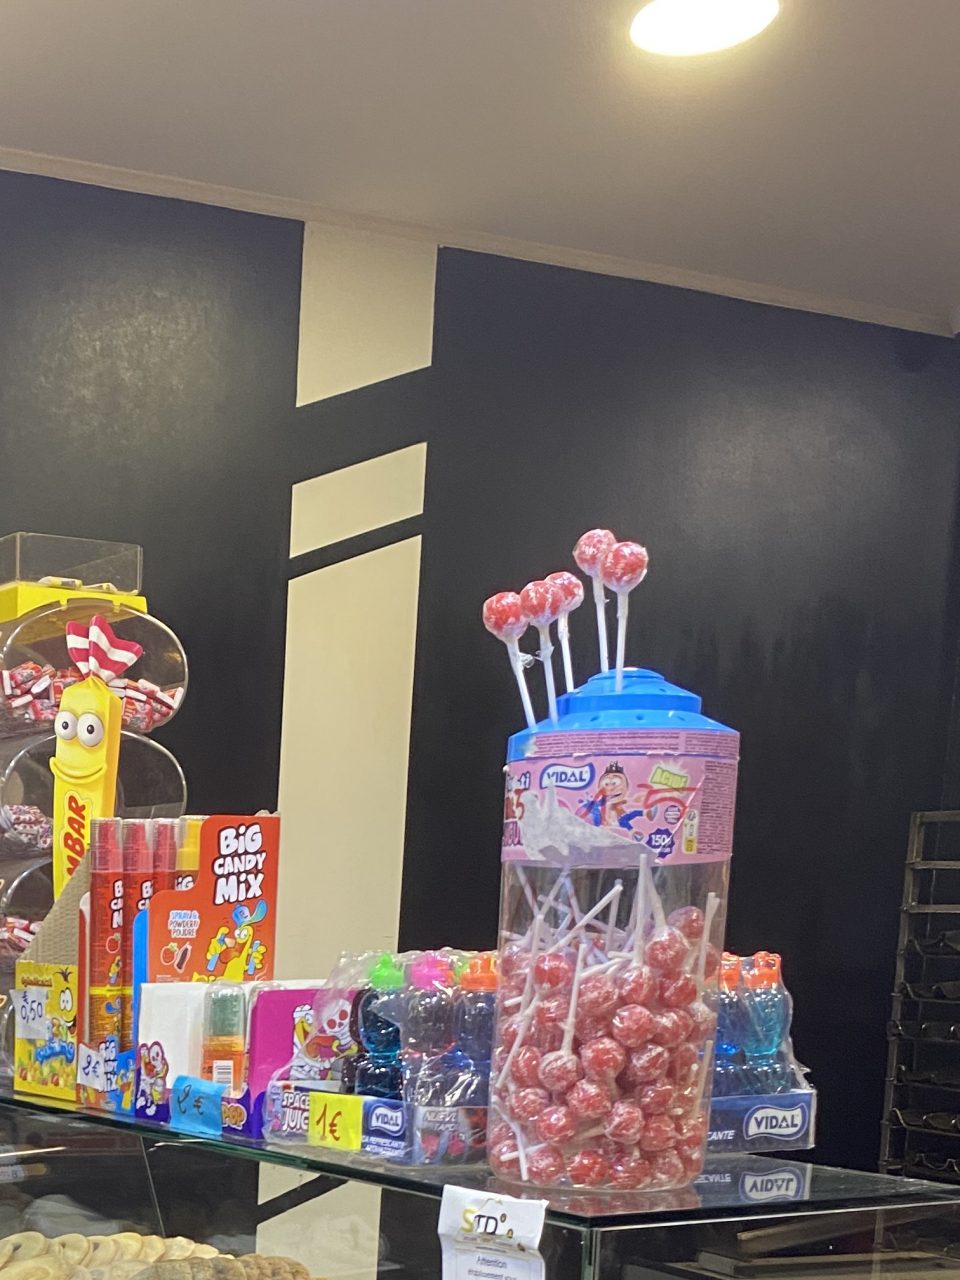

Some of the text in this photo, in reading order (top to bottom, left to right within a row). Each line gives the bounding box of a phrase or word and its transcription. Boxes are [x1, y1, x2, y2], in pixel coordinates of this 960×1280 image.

[546, 770, 587, 783] VIDAL
[213, 852, 267, 876] CANDY
[21, 1000, 44, 1024] 0,50
[374, 1112, 400, 1127] VIDAL
[753, 1114, 799, 1130] VIDAL
